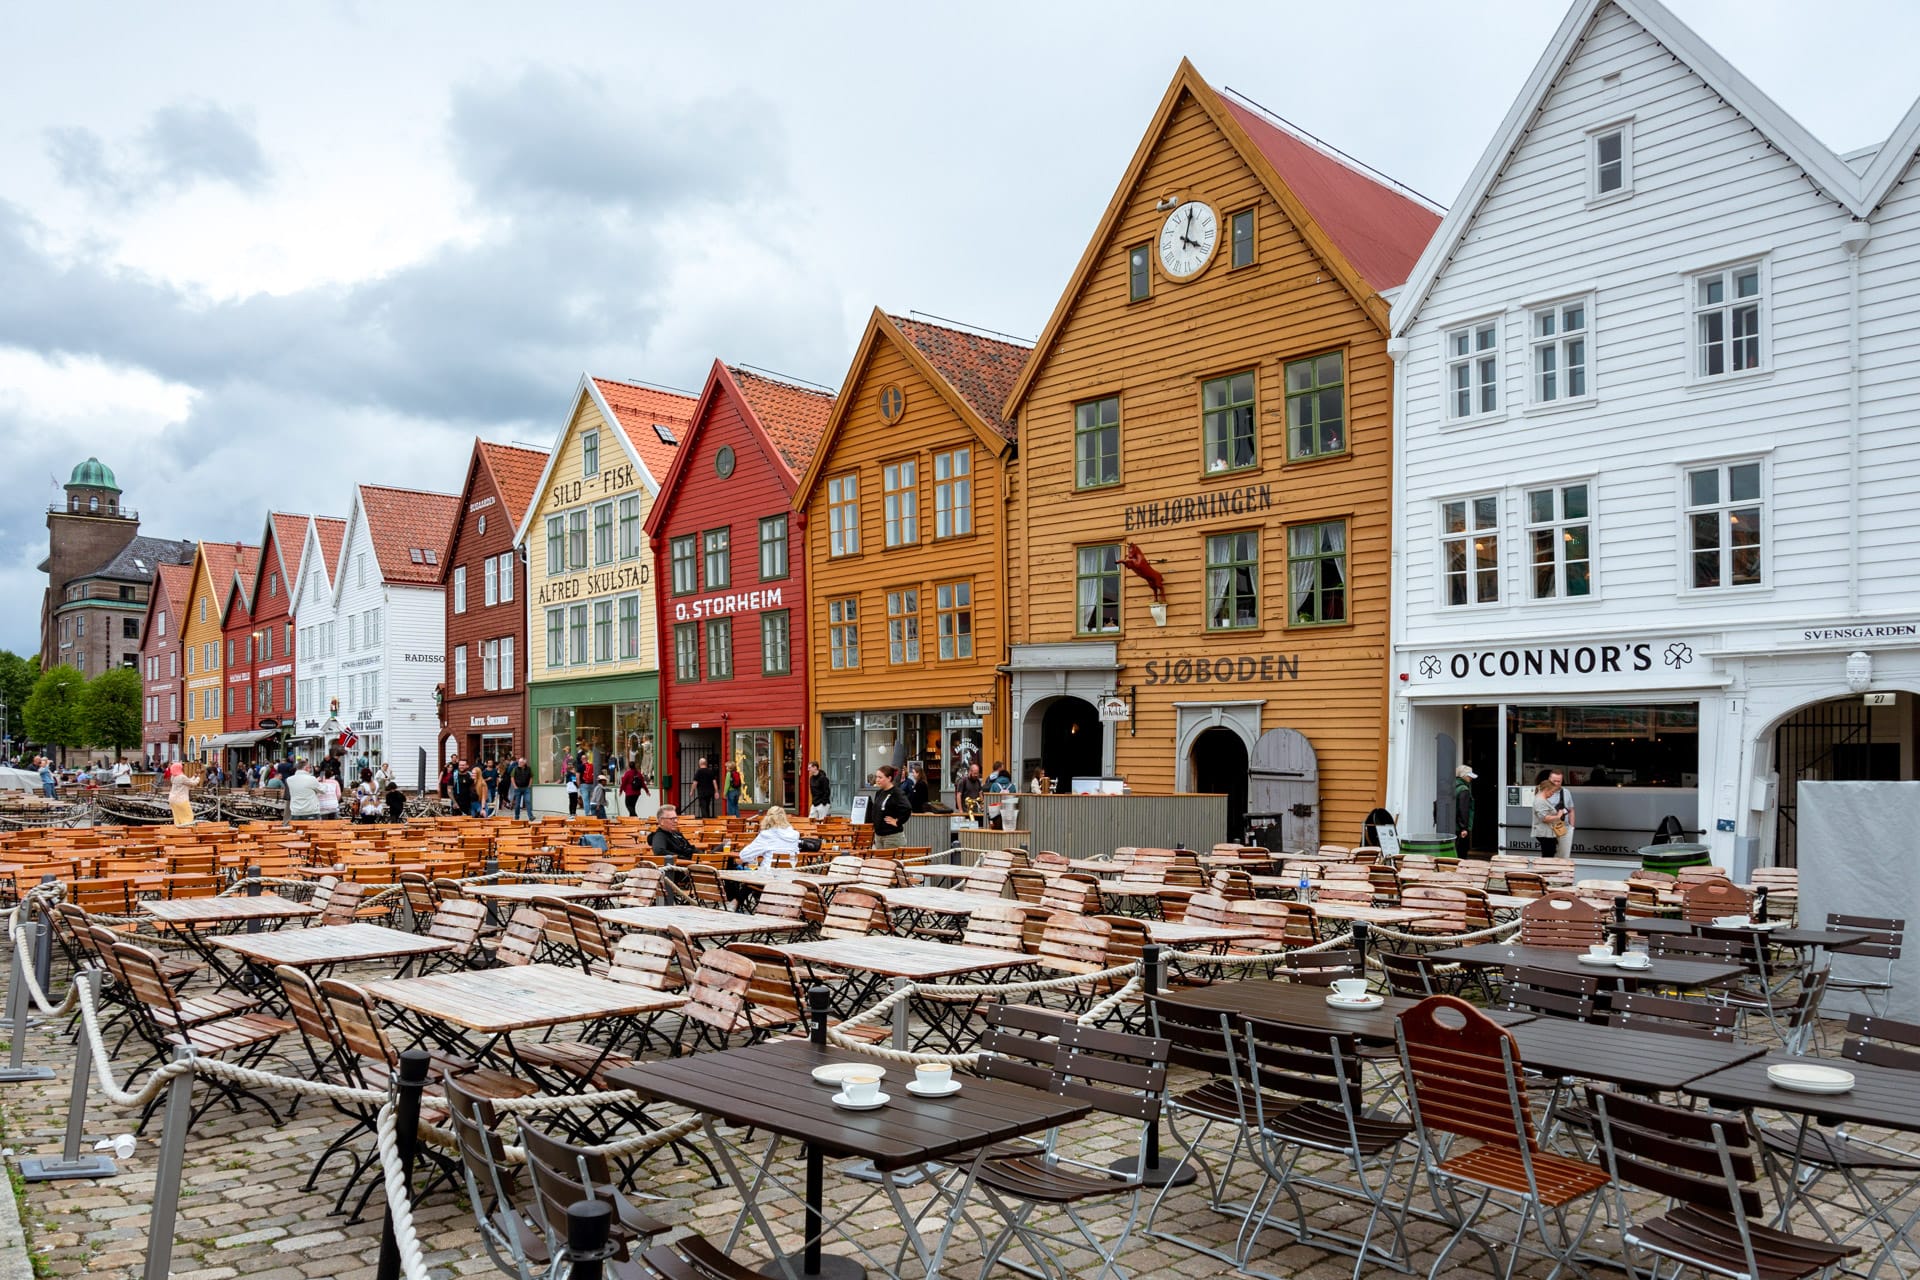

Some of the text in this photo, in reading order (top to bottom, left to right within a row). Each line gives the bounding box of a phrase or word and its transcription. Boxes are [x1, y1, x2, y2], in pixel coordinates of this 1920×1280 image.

[553, 480, 582, 507] SILD
[604, 464, 634, 493] FISK
[1124, 484, 1273, 531] ENHJØRNINGEN
[538, 565, 650, 604] ALFRED SKULSTAD
[1804, 625, 1916, 640] SVENSGARDEN
[405, 653, 446, 663] RADISSO
[1145, 654, 1299, 685] SJØBODEN
[1450, 644, 1652, 679] O'CONNOR'S
[1874, 695, 1885, 704] 27
[1510, 840, 1531, 849] IRISH
